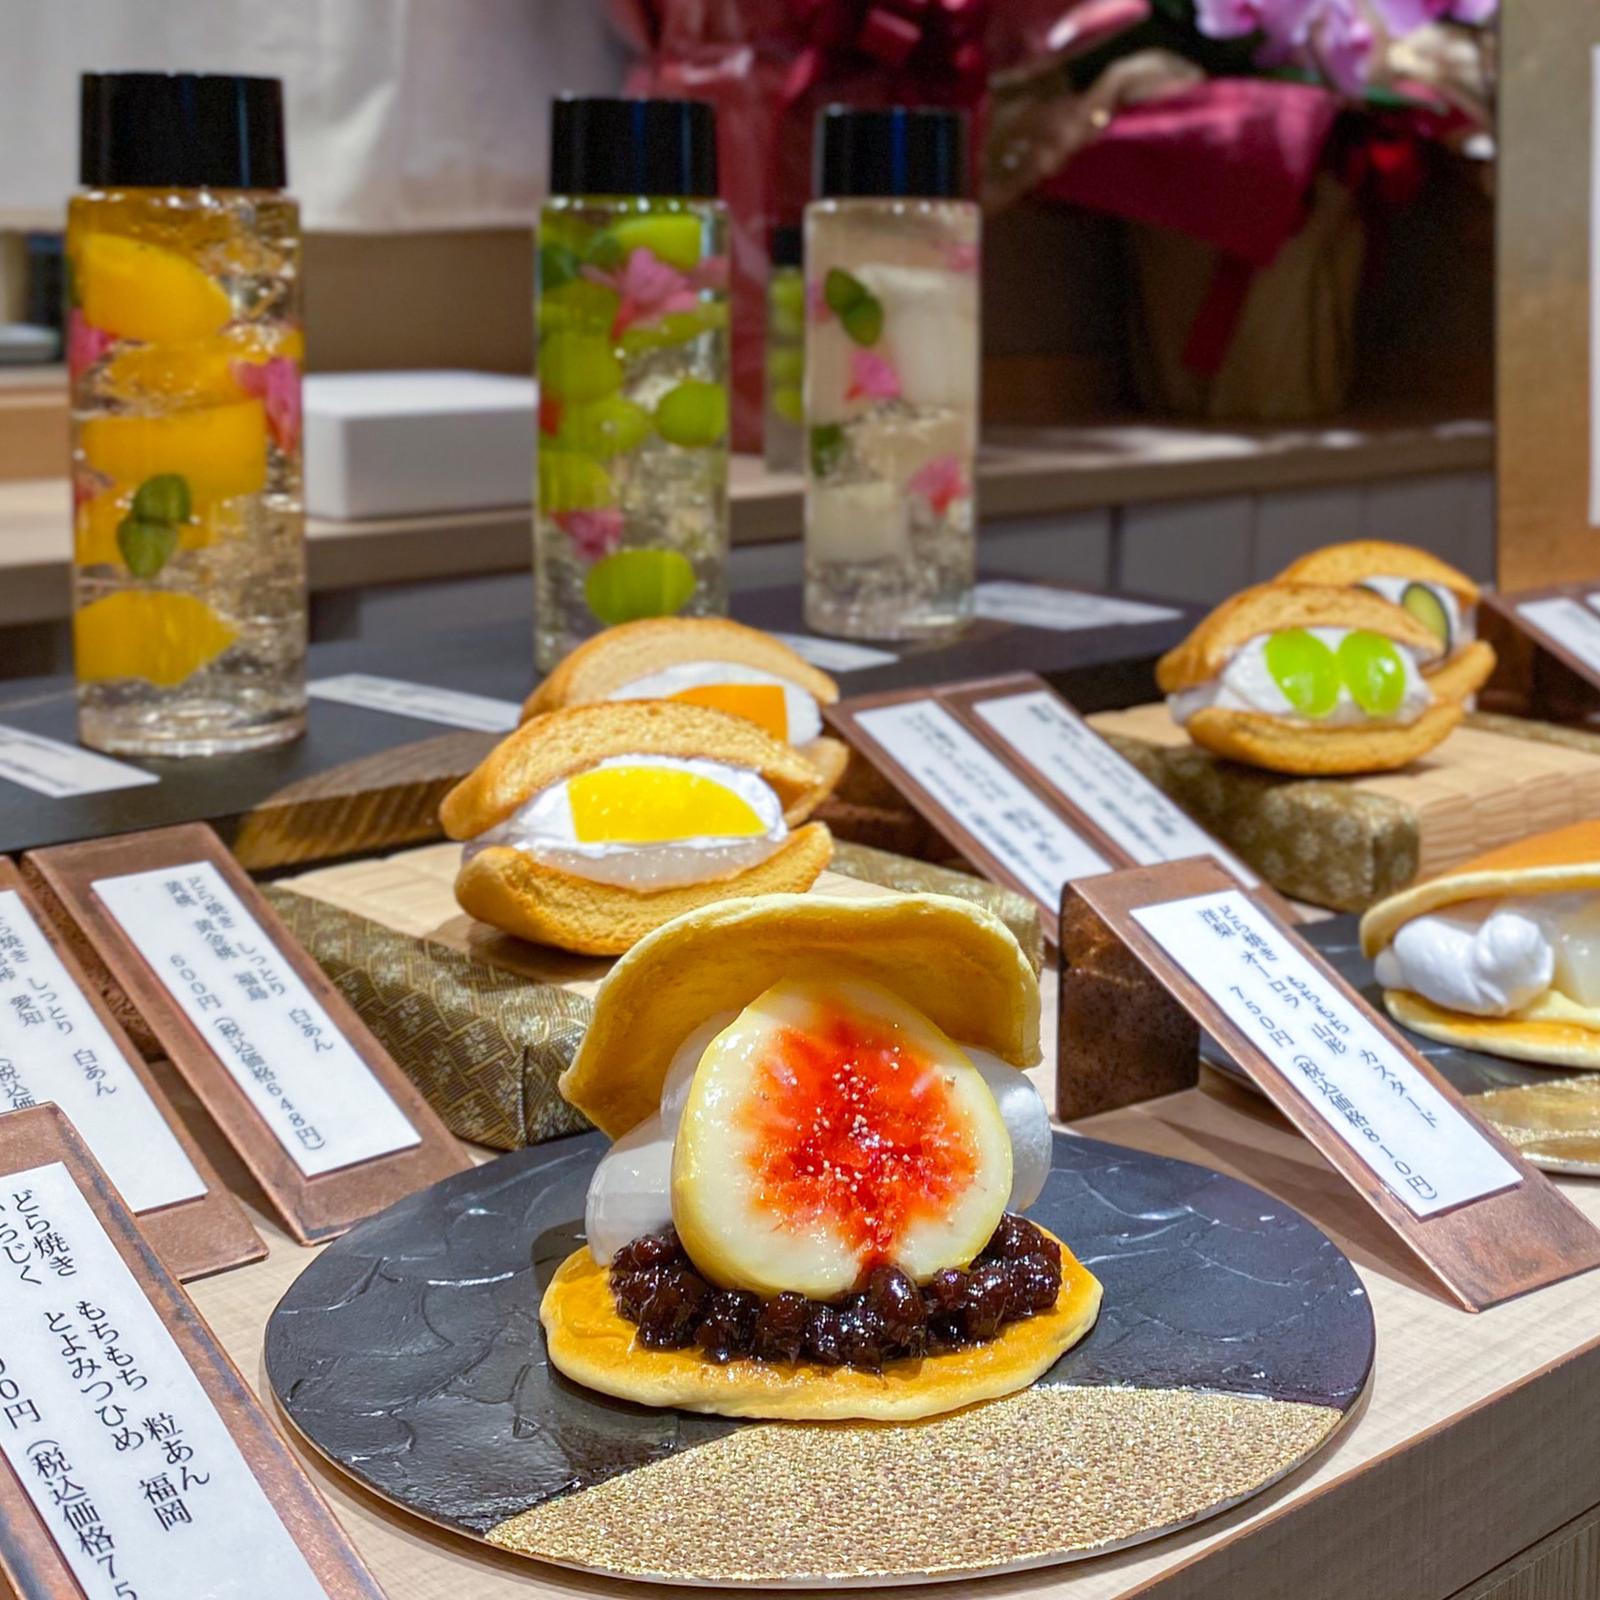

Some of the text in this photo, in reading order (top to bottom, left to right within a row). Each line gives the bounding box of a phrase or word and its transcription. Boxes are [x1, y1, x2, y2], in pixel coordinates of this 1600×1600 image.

[11, 994, 44, 1027] 愛知
[28, 977, 74, 1034] しっとり
[73, 1048, 117, 1096] 白あん
[237, 942, 285, 996] しっとり
[289, 1007, 334, 1052] 白あん
[1198, 909, 1346, 1055] 洋梨 オーロラ 山形
[1218, 905, 1438, 1128] どら焼き もちもち カスタード
[0, 1204, 193, 1532] ちじく とよみつひめ 福岡
[12, 1189, 210, 1491] どら焼き もちもち 粒あん
